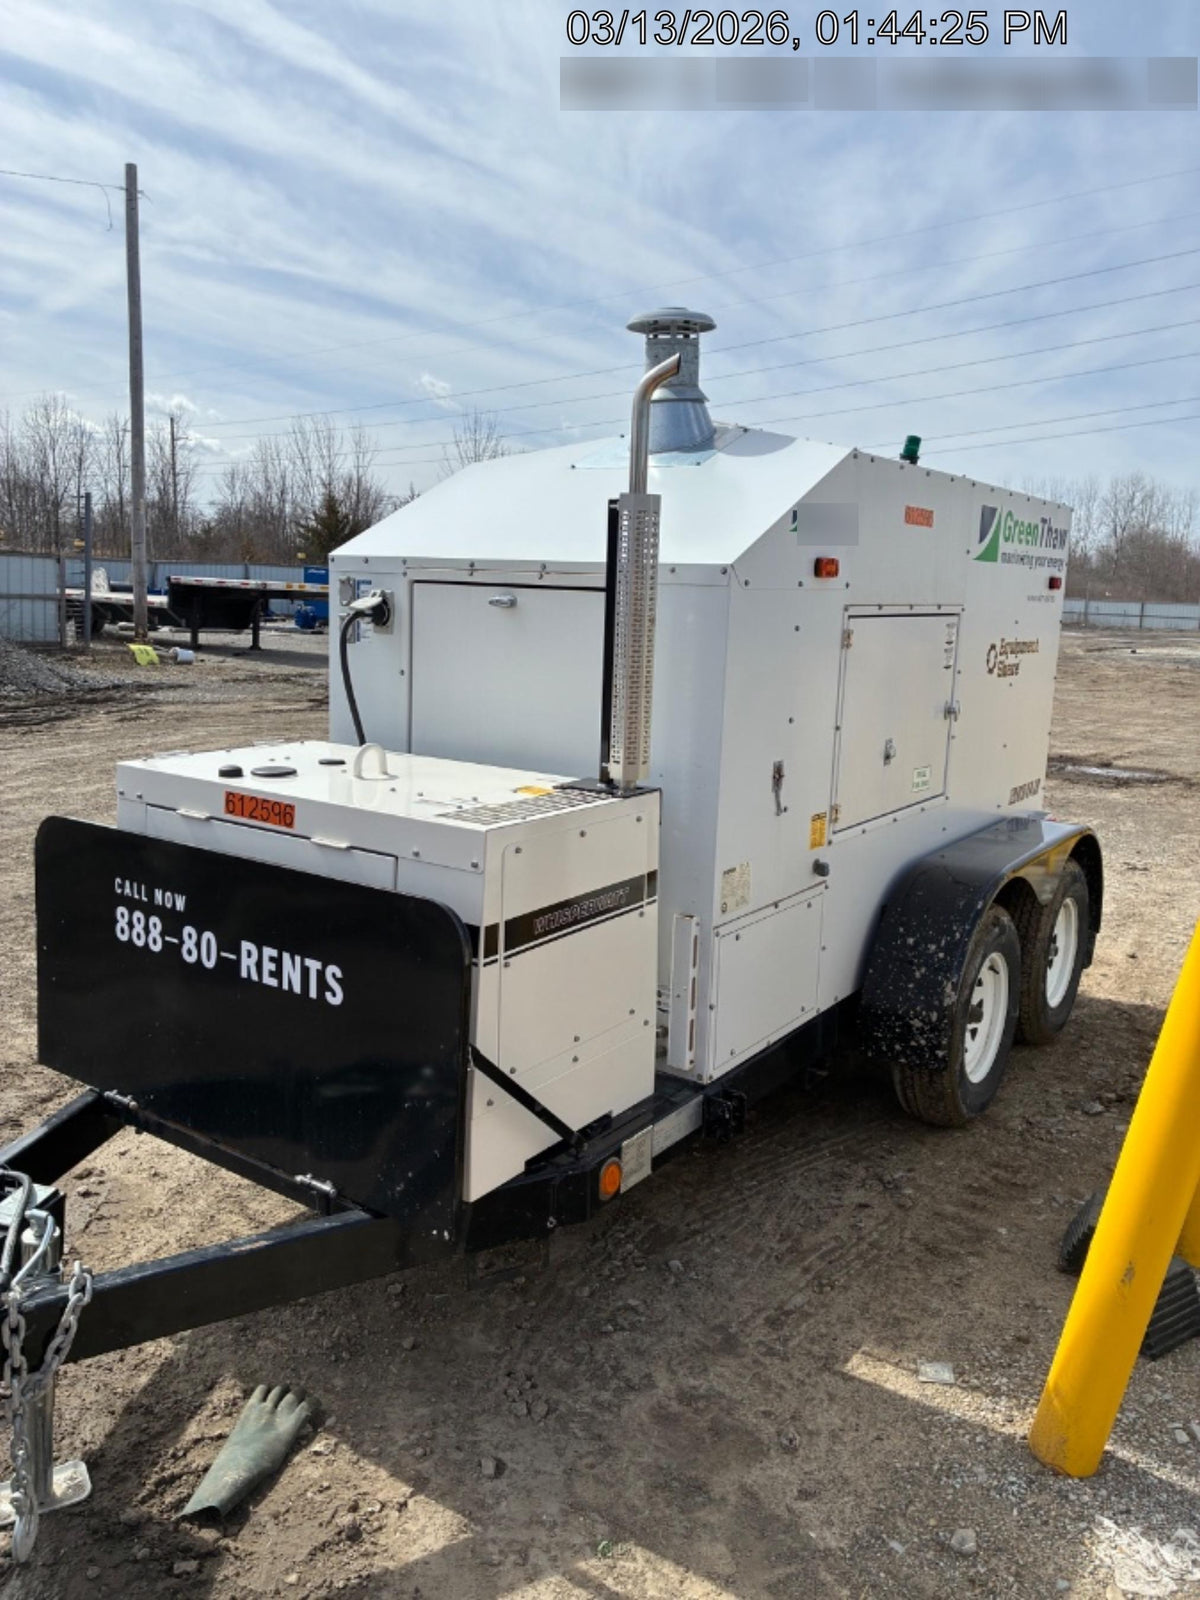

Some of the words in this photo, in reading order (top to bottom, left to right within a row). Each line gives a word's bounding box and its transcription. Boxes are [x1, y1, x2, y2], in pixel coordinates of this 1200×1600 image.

[1003, 510, 1068, 550] GreenThaw
[224, 791, 295, 828] 612596
[114, 877, 149, 904] CALL
[154, 888, 187, 913] NOW
[114, 905, 345, 1007] 888-80-RENTS
